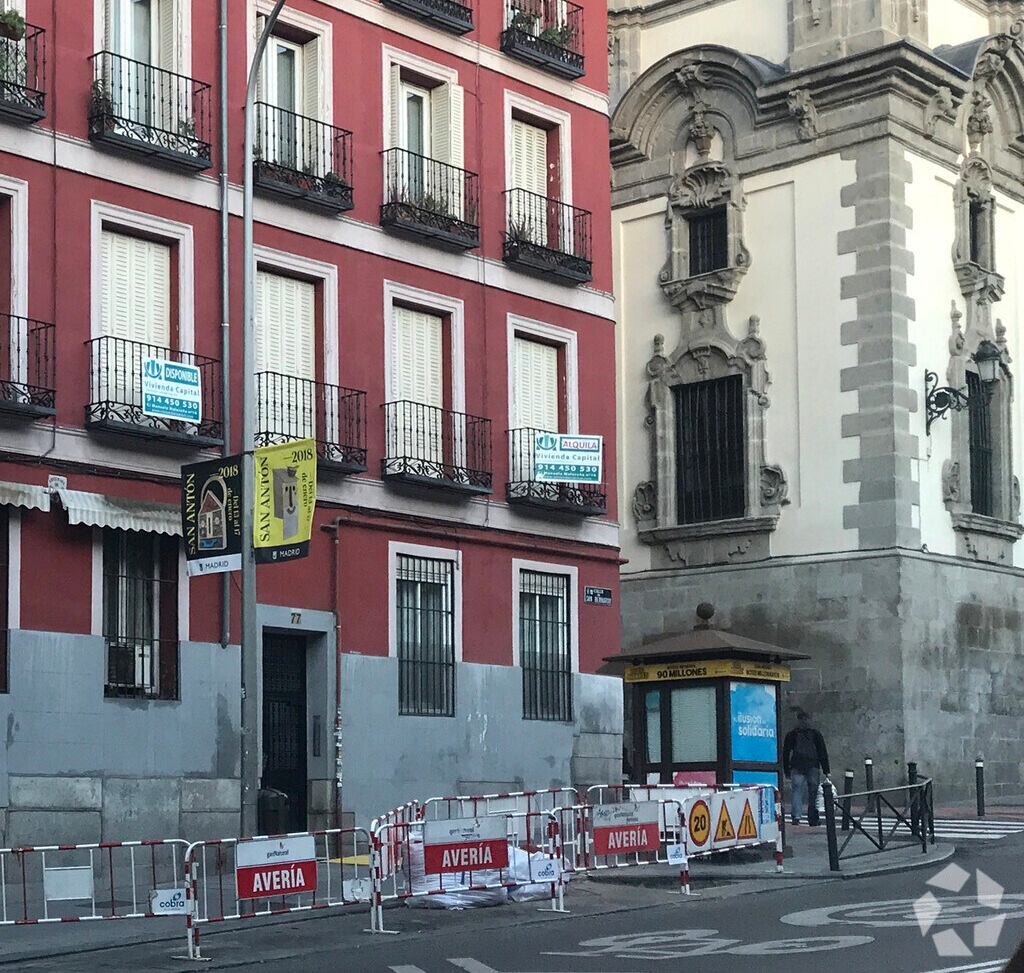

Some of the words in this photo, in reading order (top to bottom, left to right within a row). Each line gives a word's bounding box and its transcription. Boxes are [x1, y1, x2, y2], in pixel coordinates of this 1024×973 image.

[165, 367, 198, 383] DISPONIBLE
[144, 381, 174, 392] Vivienda
[175, 386, 200, 396] Capital
[146, 394, 162, 403] 914
[164, 398, 180, 406] 450
[182, 401, 198, 409] 530
[562, 441, 597, 450] ALQUILA
[259, 457, 270, 510] ANTÓN
[184, 473, 196, 524] ANTÓN
[260, 512, 270, 543] SAN
[186, 526, 196, 555] SAN
[280, 548, 301, 558] MADRID
[205, 561, 229, 570] MADRID
[290, 612, 302, 624] 77
[656, 670, 668, 679] 90
[669, 667, 708, 678] MILLONES
[738, 725, 775, 737] solidaria
[693, 814, 707, 833] 20
[608, 827, 648, 850] AVERÍA
[442, 843, 493, 868] AVERÍA
[252, 864, 306, 893] AVERÍA
[159, 897, 185, 908] cobra
